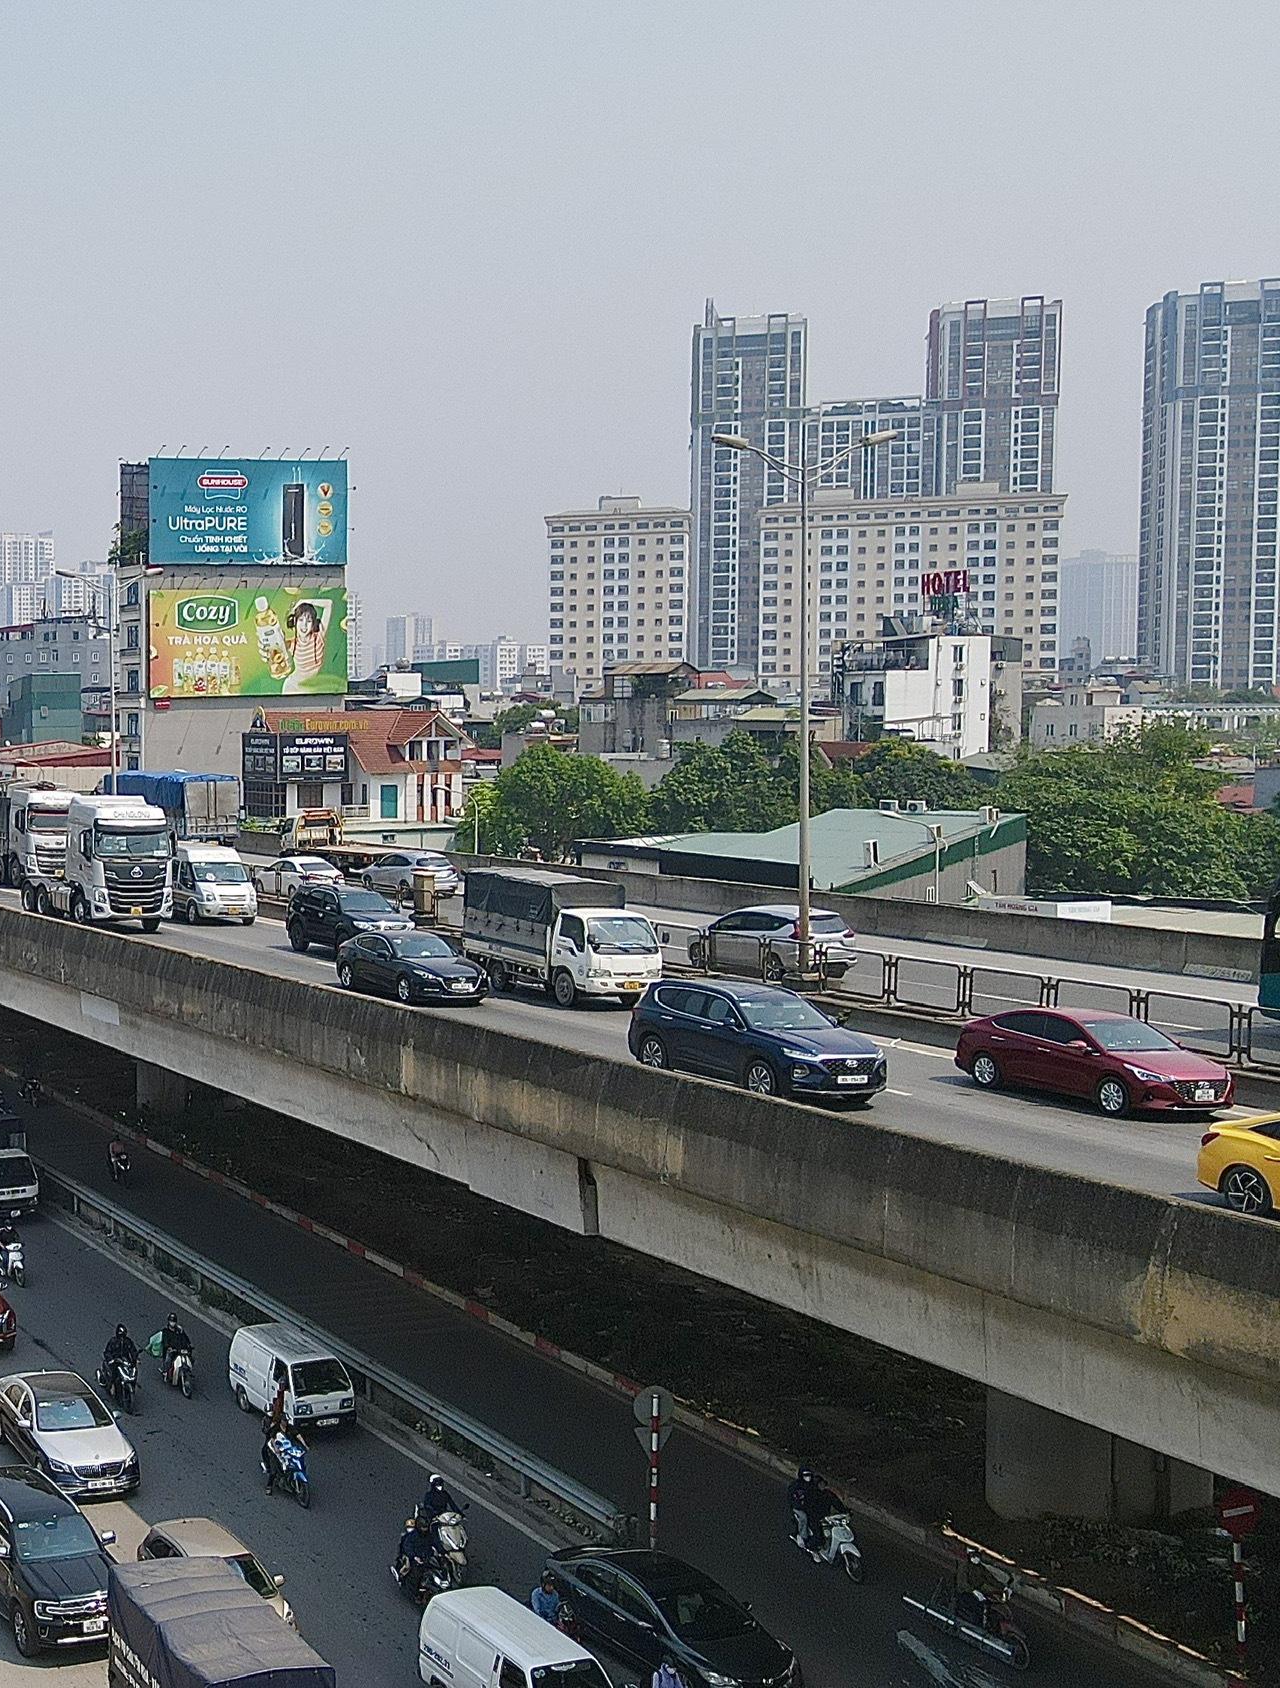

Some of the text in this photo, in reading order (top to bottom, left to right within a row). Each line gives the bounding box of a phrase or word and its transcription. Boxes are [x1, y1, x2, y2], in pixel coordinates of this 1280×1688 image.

[168, 515, 248, 530] UltraPURE
[921, 569, 970, 595] HOTEL
[182, 602, 231, 625] Cozy
[167, 632, 248, 647] TRÀ HOA QUẢ
[295, 737, 334, 745] EUROWIN
